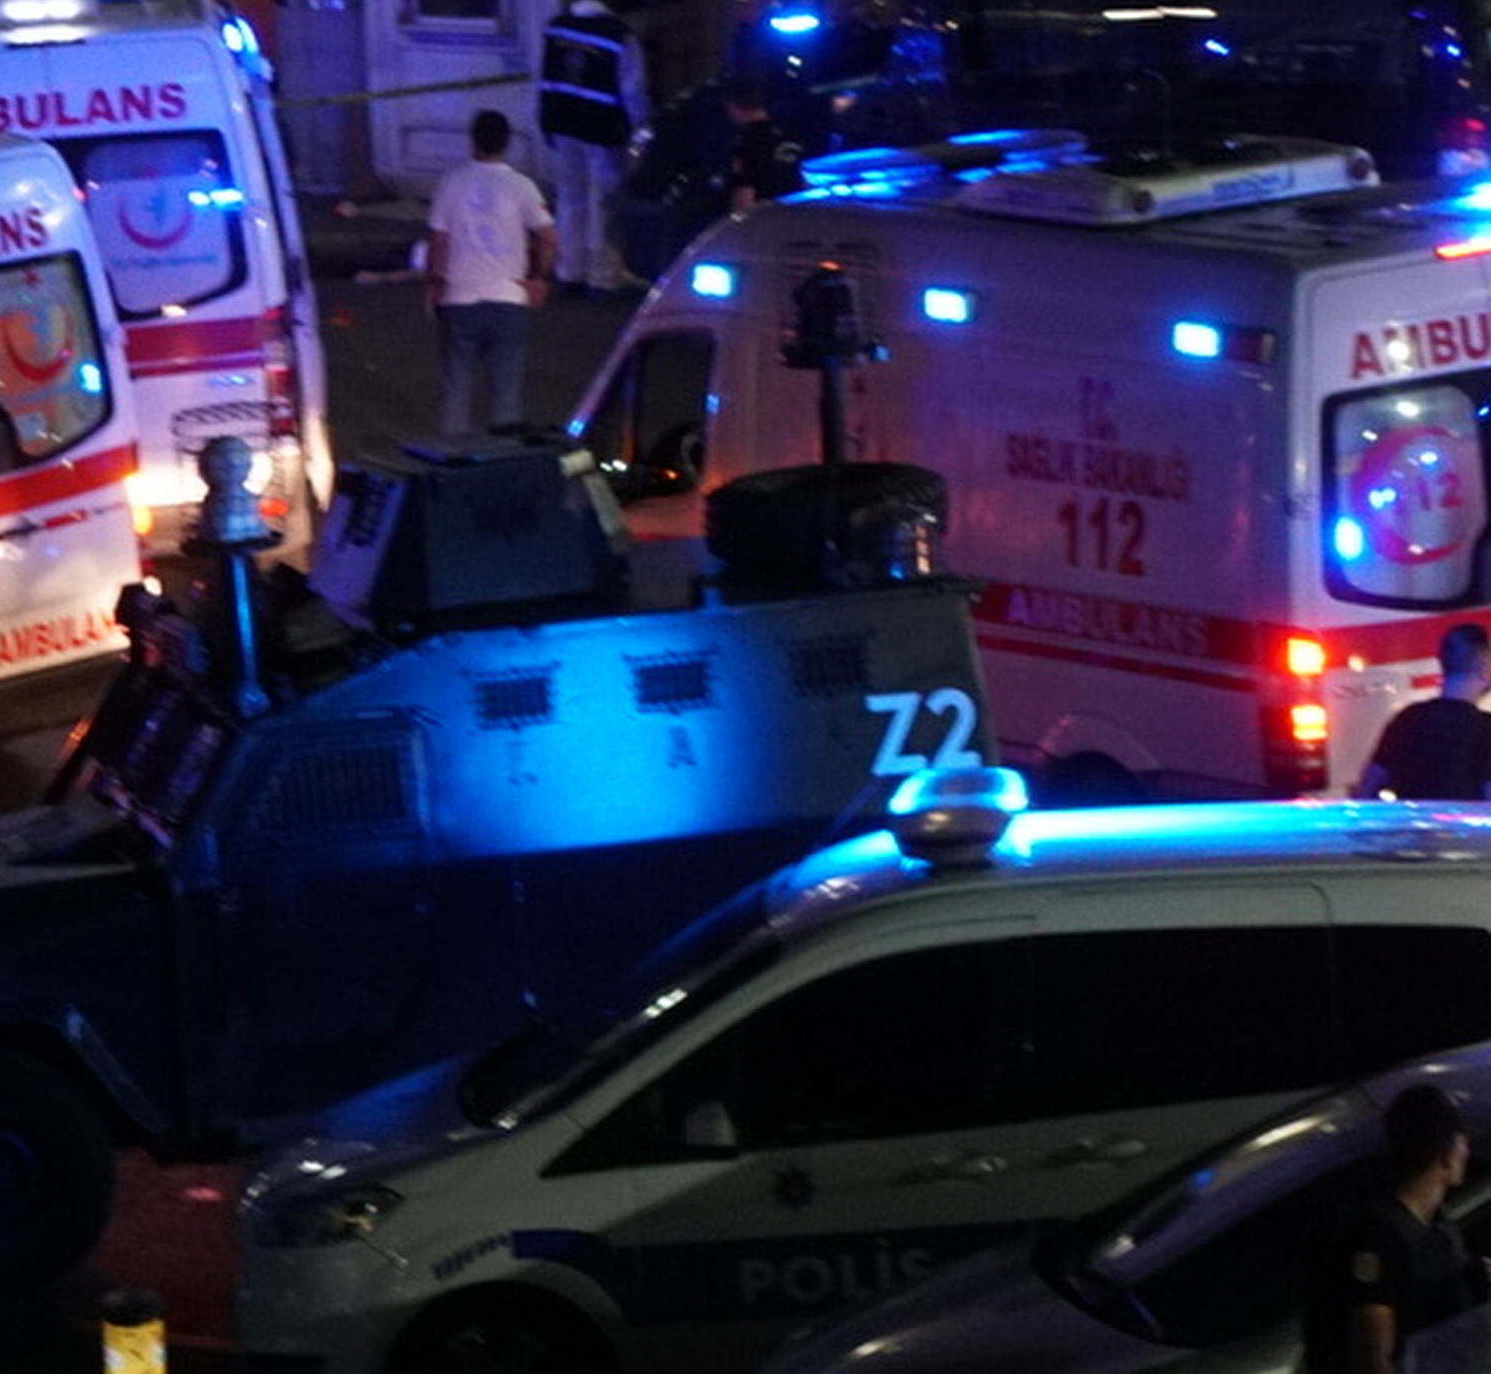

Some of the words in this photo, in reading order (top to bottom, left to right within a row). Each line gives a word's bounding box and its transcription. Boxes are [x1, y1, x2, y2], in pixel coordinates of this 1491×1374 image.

[1059, 493, 1144, 576] 112
[1007, 589, 1208, 657] AMBULANS
[864, 687, 985, 777] Z2
